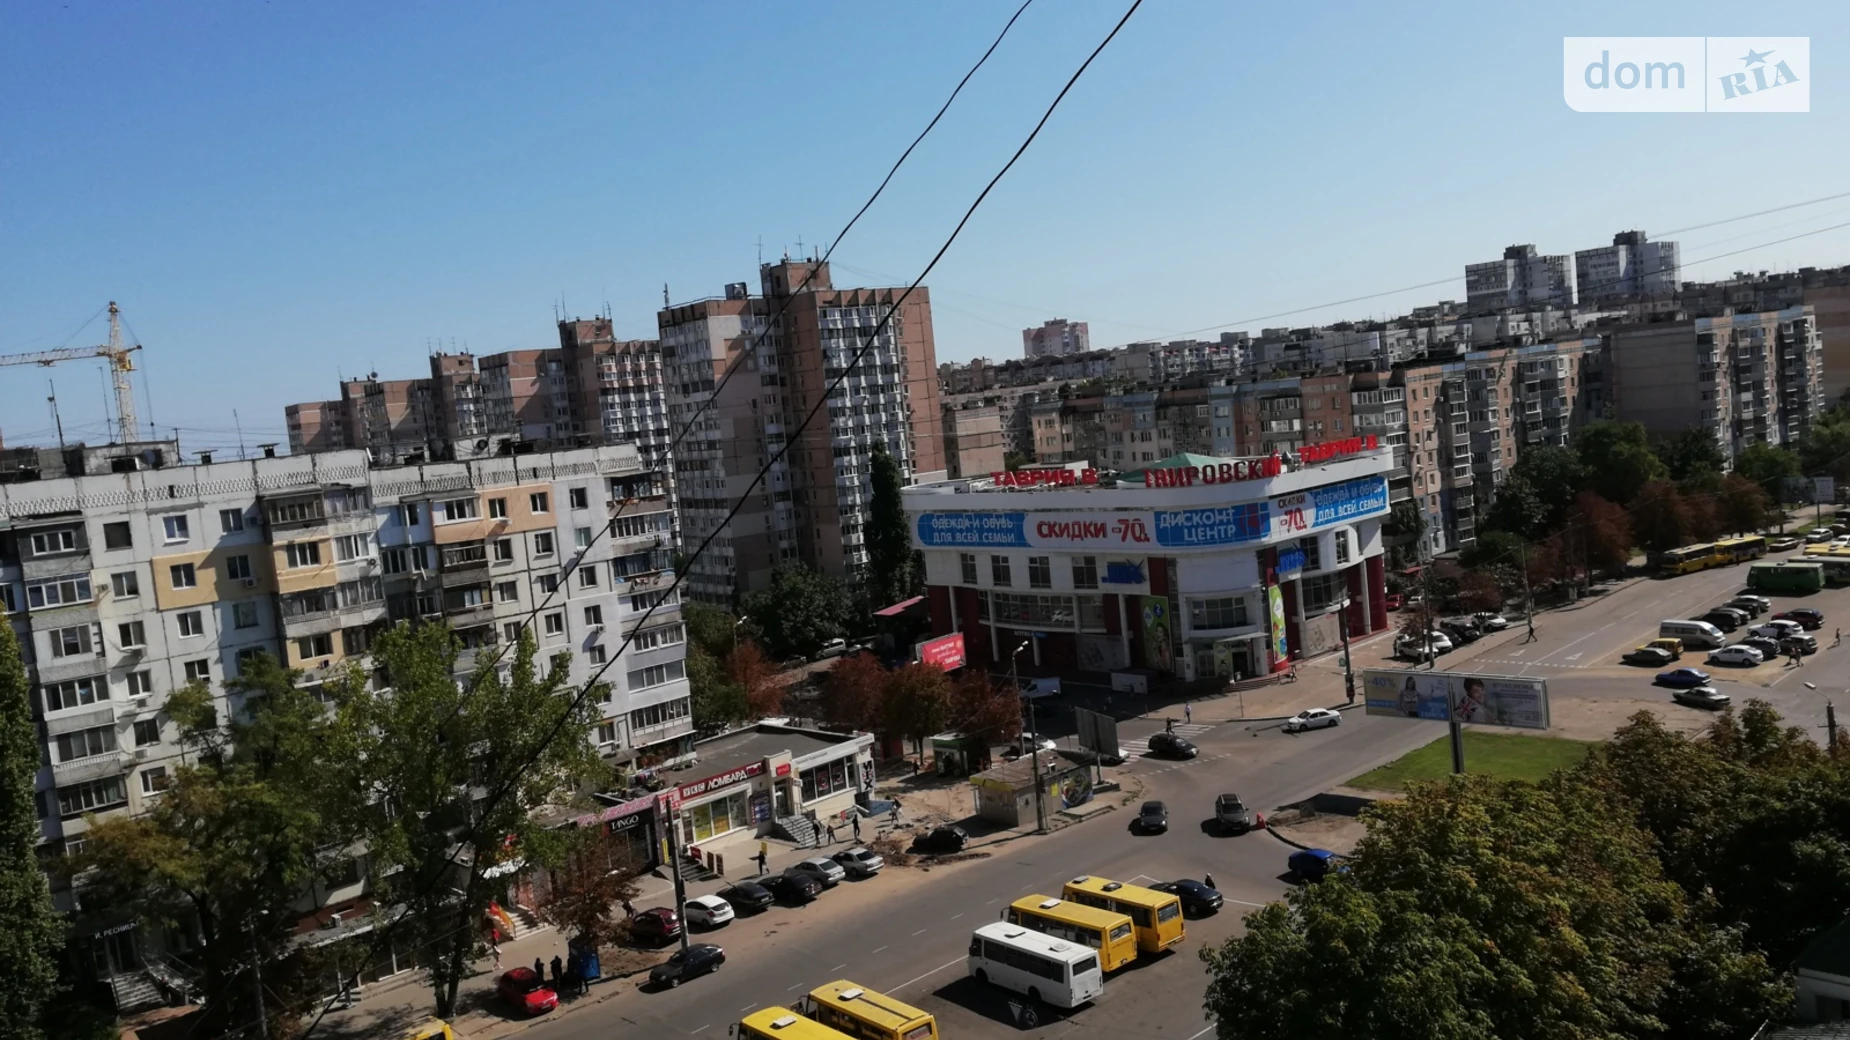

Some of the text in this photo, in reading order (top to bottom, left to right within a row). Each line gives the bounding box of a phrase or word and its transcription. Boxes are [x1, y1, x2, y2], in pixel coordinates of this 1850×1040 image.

[1297, 434, 1378, 462] ТАВРИЯ В
[990, 467, 1098, 487] ТАВРИЯ В
[1159, 508, 1236, 529] ДИСКОНТ
[1318, 497, 1384, 523] ДЛЯ ВСЕЙ СЕМЬИ
[932, 517, 1013, 530] ОДЕЖДА И ОБУВЬ
[1036, 520, 1108, 541] СКИДКИ
[1184, 525, 1236, 542] ЦЕНТР
[933, 530, 1015, 544] ДЛЯ ВСЕЙ СЕМЬИ
[707, 769, 747, 791] ЛОМБАРД
[611, 815, 639, 830] TANGO
